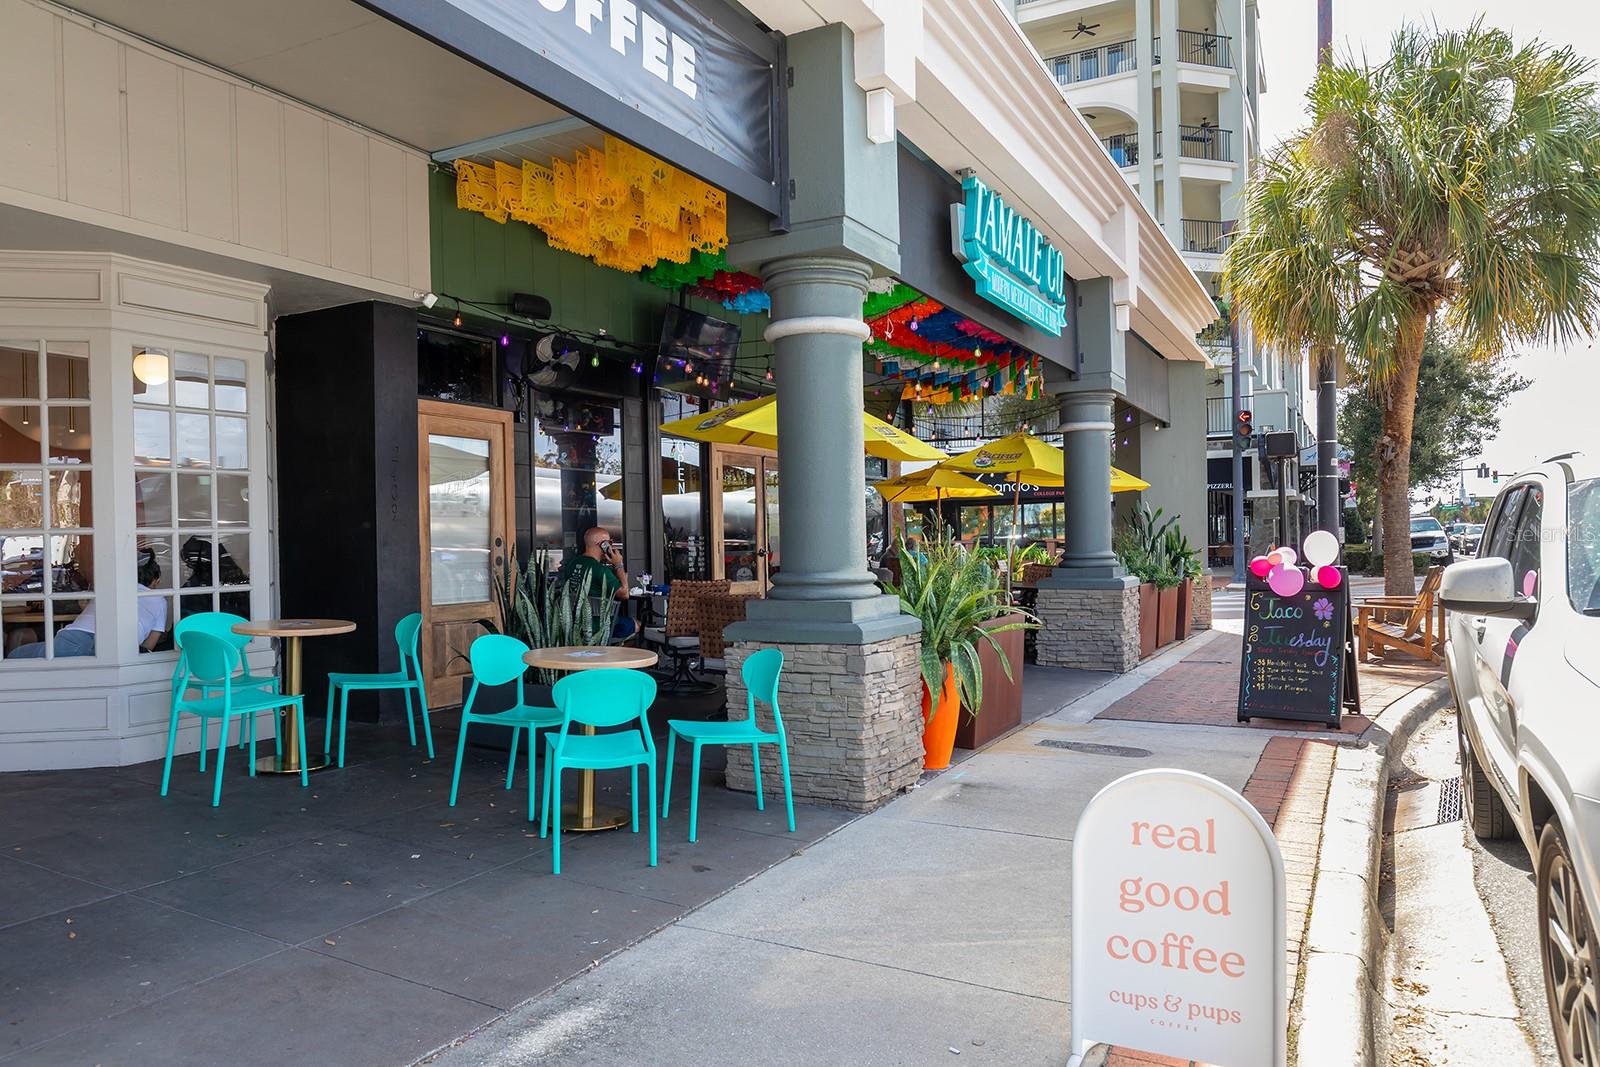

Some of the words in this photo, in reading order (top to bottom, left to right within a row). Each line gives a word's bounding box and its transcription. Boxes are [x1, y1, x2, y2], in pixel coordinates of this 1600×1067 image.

[974, 176, 1043, 286] TAMALE
[677, 440, 686, 495] OPEN
[1259, 597, 1303, 620] Taco
[1260, 625, 1332, 667] Tuesday
[1131, 818, 1217, 854] real
[1119, 876, 1231, 916] good
[1106, 932, 1246, 978] coffee
[1109, 990, 1158, 1010] cups
[1164, 994, 1182, 1013] &
[1188, 1003, 1242, 1025] pups
[1150, 1018, 1198, 1032] COFFEE
